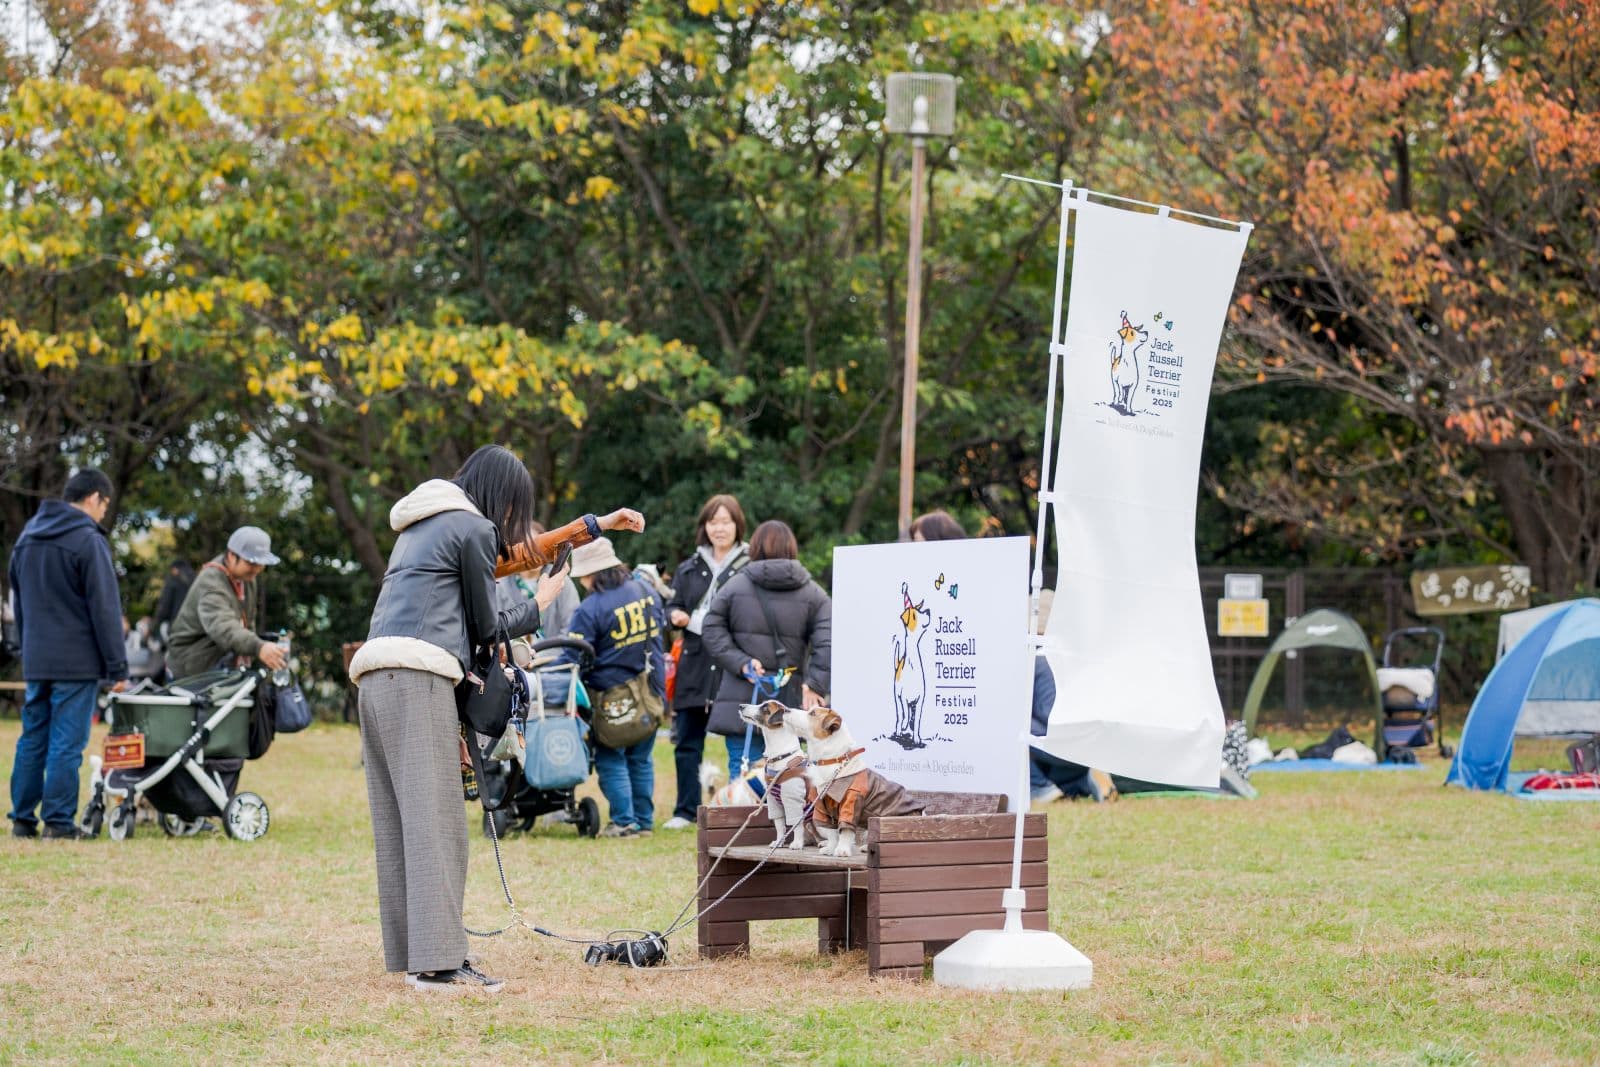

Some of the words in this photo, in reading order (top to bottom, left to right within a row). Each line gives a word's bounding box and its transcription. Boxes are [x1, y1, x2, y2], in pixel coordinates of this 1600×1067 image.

[1150, 338, 1174, 352] Jack
[1148, 351, 1183, 367] Russell
[1147, 365, 1182, 381] Terrier
[1145, 385, 1180, 398] Festival
[1152, 398, 1173, 408] 2025
[935, 616, 962, 633] Jack
[934, 638, 976, 656] Russell
[935, 662, 976, 680] Terrier
[935, 694, 976, 707] Festival
[944, 713, 968, 725] 2025
